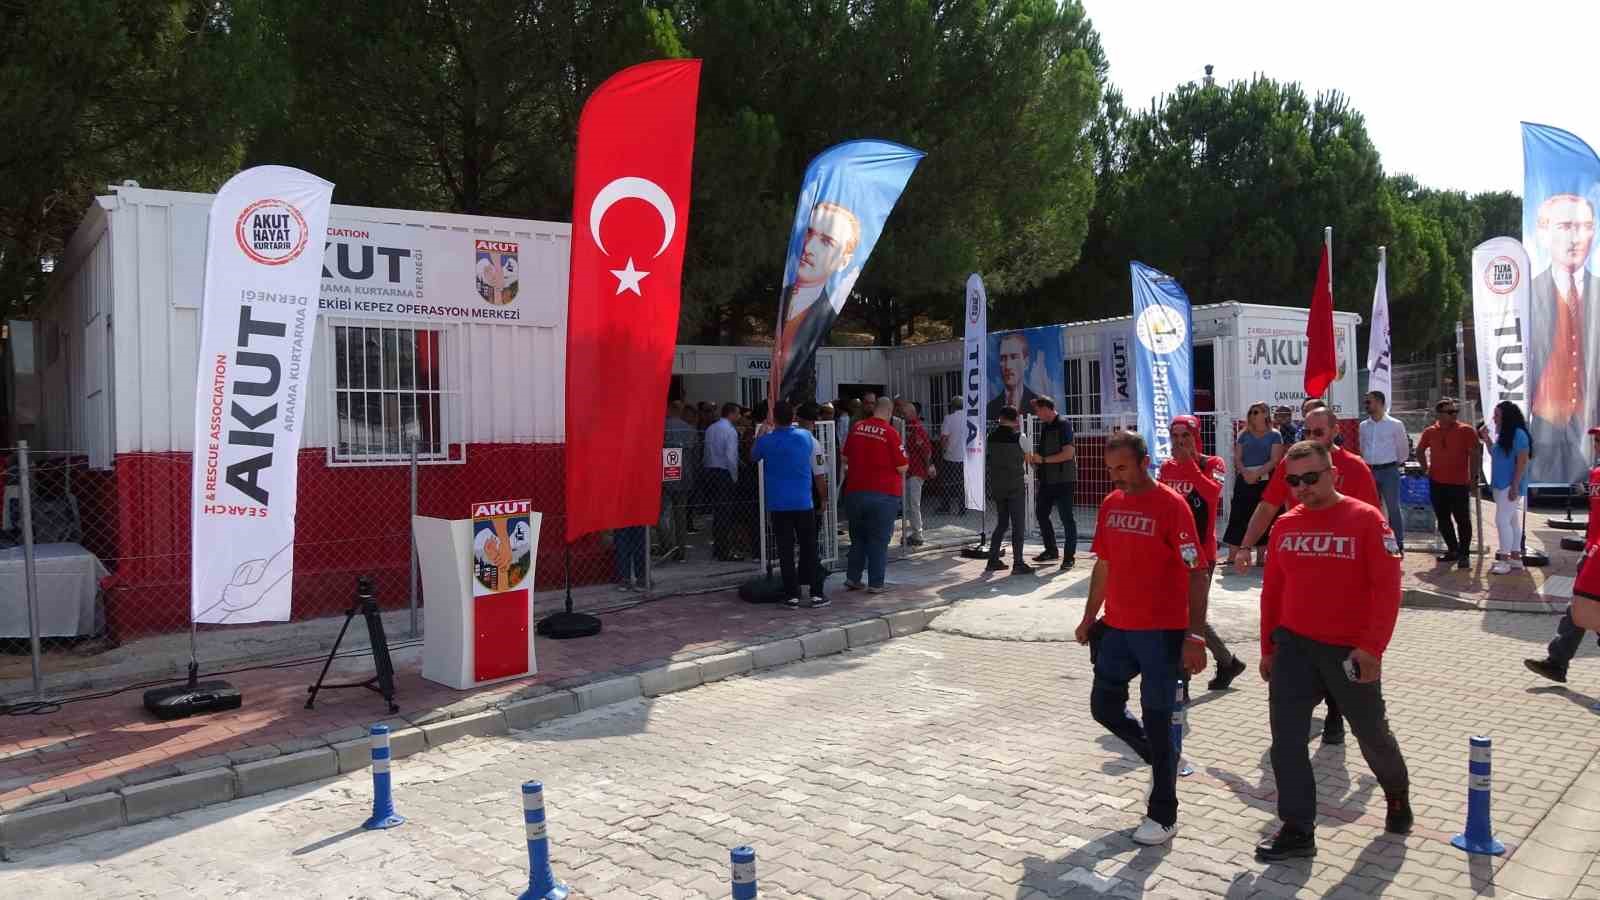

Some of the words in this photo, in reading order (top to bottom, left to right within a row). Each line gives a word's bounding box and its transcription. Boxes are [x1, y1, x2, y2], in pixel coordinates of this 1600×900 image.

[253, 214, 290, 229] AKUT
[253, 229, 291, 242] HAYAT
[326, 227, 369, 239] CIATION
[254, 241, 291, 250] KURTARIR
[476, 241, 519, 252] AKUT
[320, 283, 351, 294] AMA
[354, 285, 415, 298] KURTARMA
[318, 297, 352, 310] EKİBİ
[354, 300, 394, 313] KEPEZ
[396, 304, 469, 317] OPERASYON
[471, 308, 520, 320] MERKEZİ
[289, 308, 306, 381] KURTARMA
[1253, 338, 1308, 366] AKU
[748, 359, 772, 369] AKU
[1113, 342, 1129, 399] AKUT
[209, 354, 227, 440] ASSOCIATION
[225, 304, 287, 506] AKUT
[283, 383, 299, 433] ARAMA
[205, 442, 219, 491] RESCUE
[204, 503, 268, 518] SEARCH
[474, 501, 530, 517] AKUT
[1106, 512, 1153, 531] AKUT
[1279, 535, 1349, 553] AKUT
